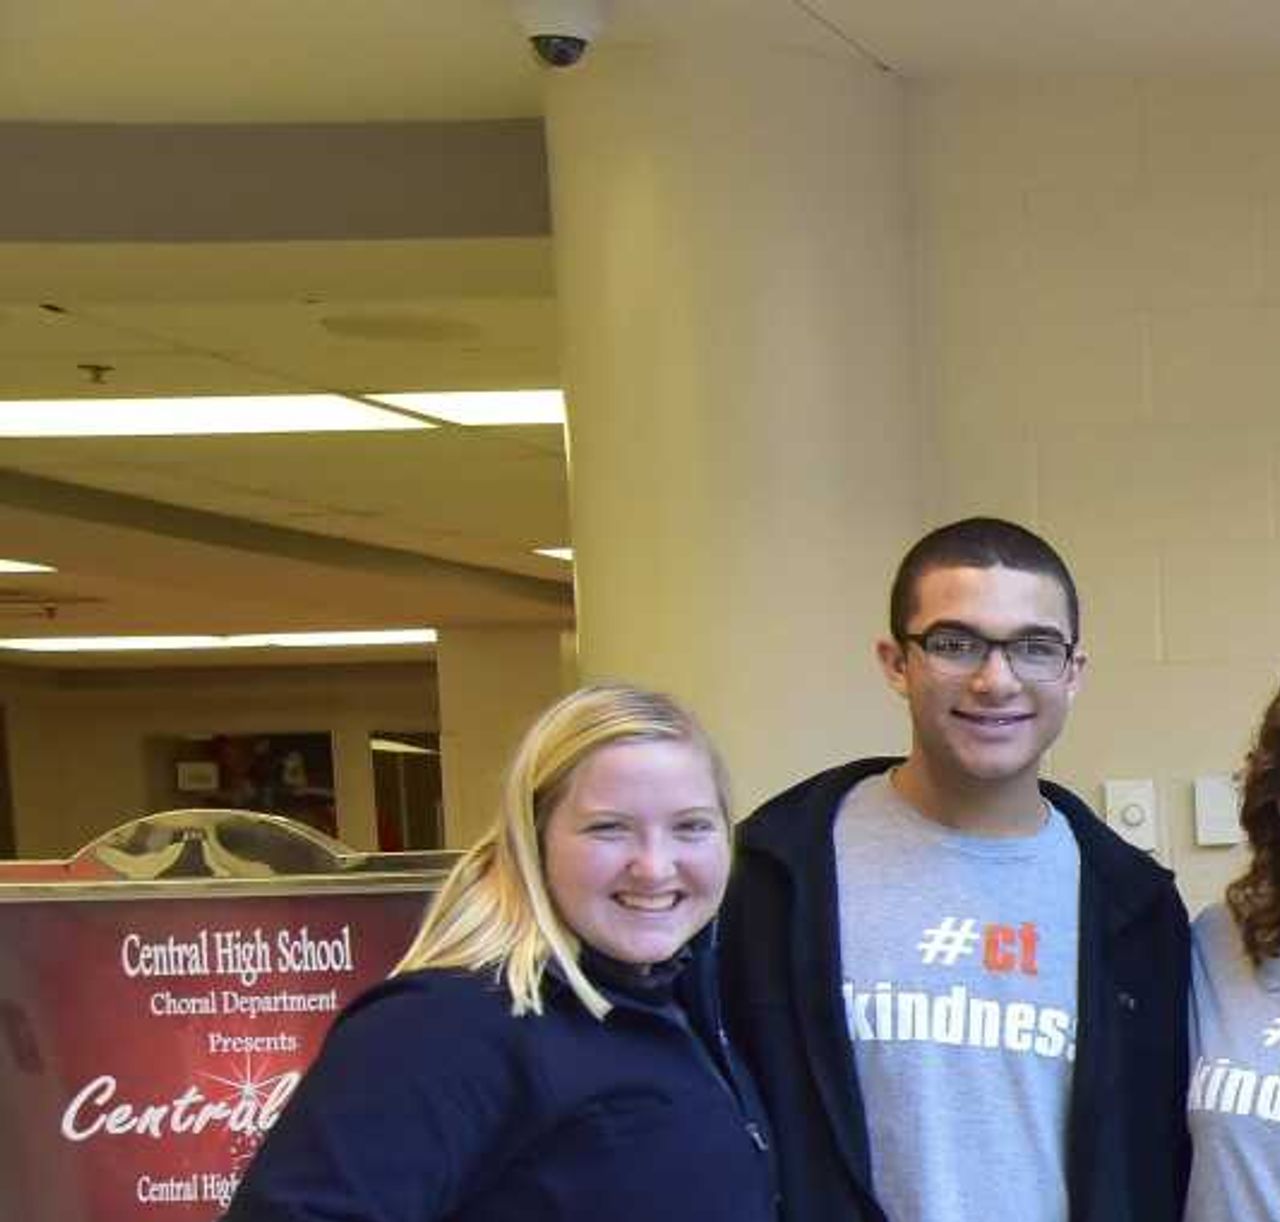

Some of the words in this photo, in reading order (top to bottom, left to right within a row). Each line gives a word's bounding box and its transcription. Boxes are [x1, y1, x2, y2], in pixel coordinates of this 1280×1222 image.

[122, 930, 210, 977] Central
[214, 928, 273, 986] High
[277, 923, 354, 972] School
[918, 917, 1040, 976] #ct
[151, 990, 217, 1015] Choral
[222, 988, 337, 1019] Department
[842, 981, 1077, 1062] kindnes
[208, 1032, 298, 1052] Presents
[61, 1071, 302, 1141] Central
[137, 1174, 198, 1202] Central
